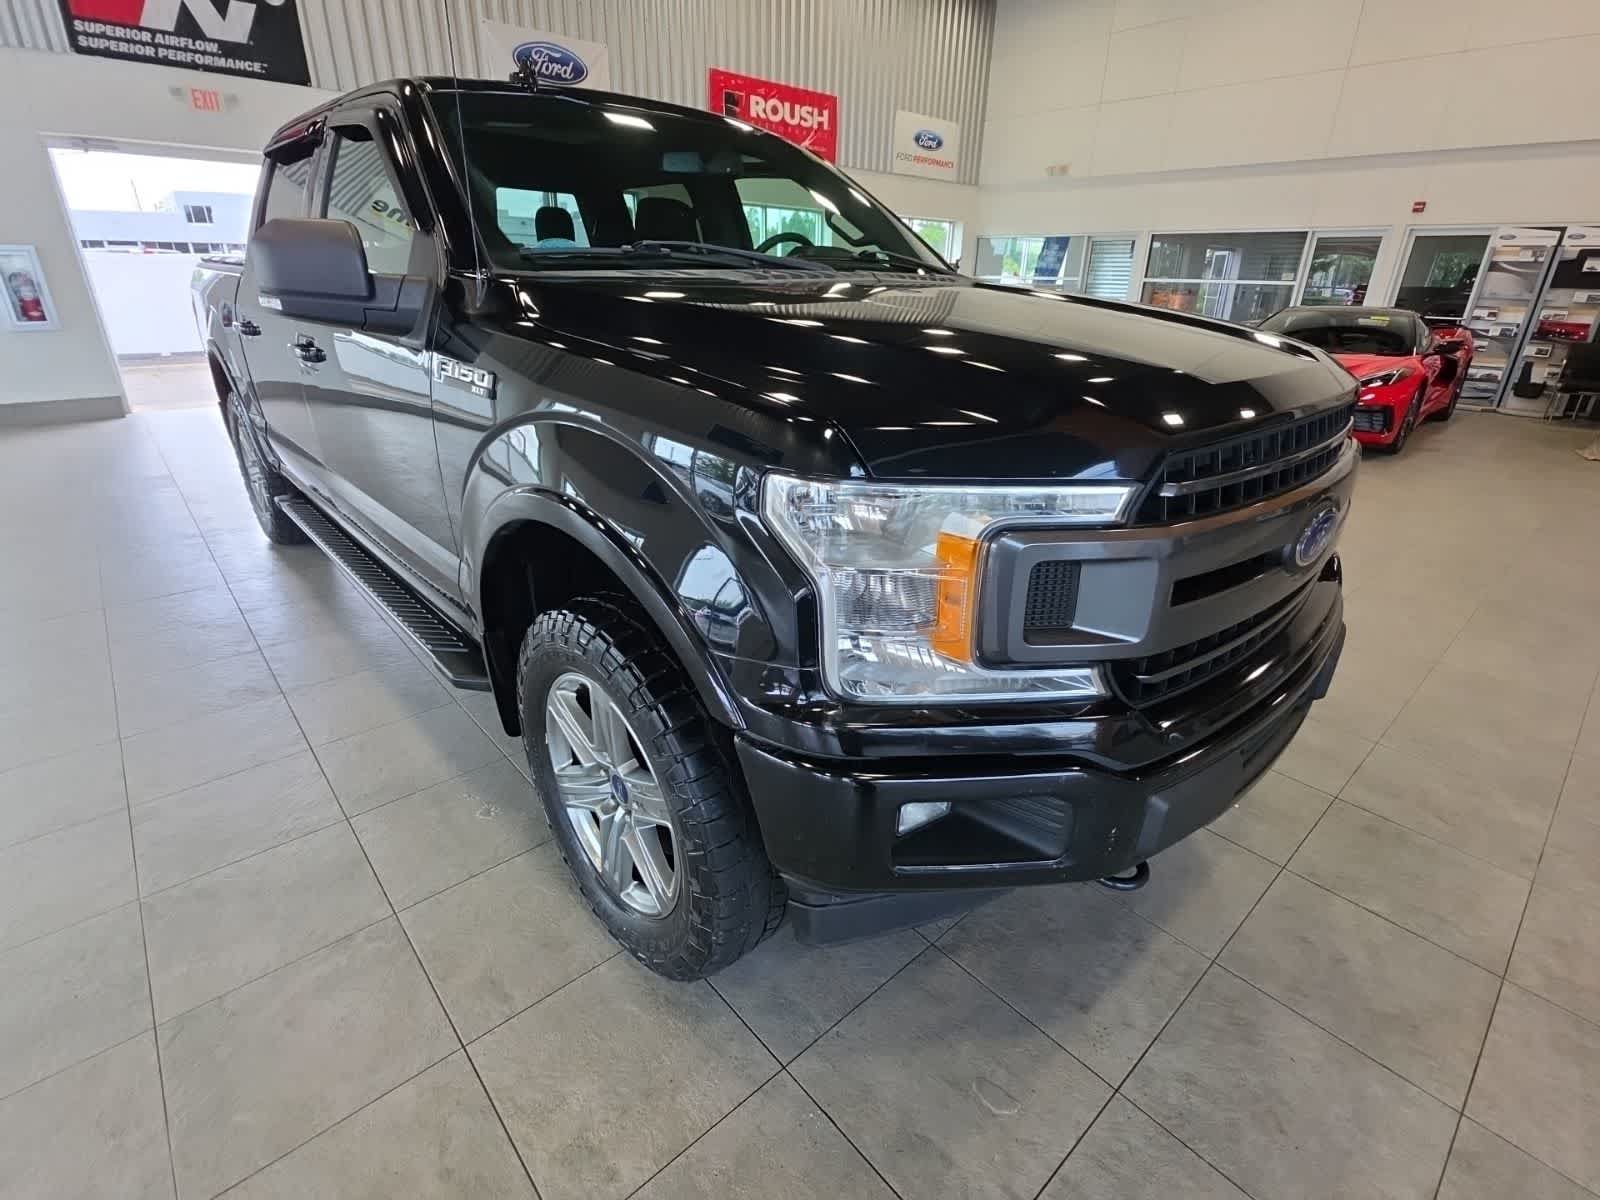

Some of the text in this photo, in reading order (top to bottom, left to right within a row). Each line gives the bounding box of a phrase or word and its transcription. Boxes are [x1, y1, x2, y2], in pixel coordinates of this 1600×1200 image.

[73, 19, 222, 54] SUPERIOR AIRFLOW.
[77, 35, 156, 57] SUPERIOR
[531, 47, 575, 79] Ford
[191, 88, 220, 111] EXIT
[749, 94, 829, 131] ROUSH
